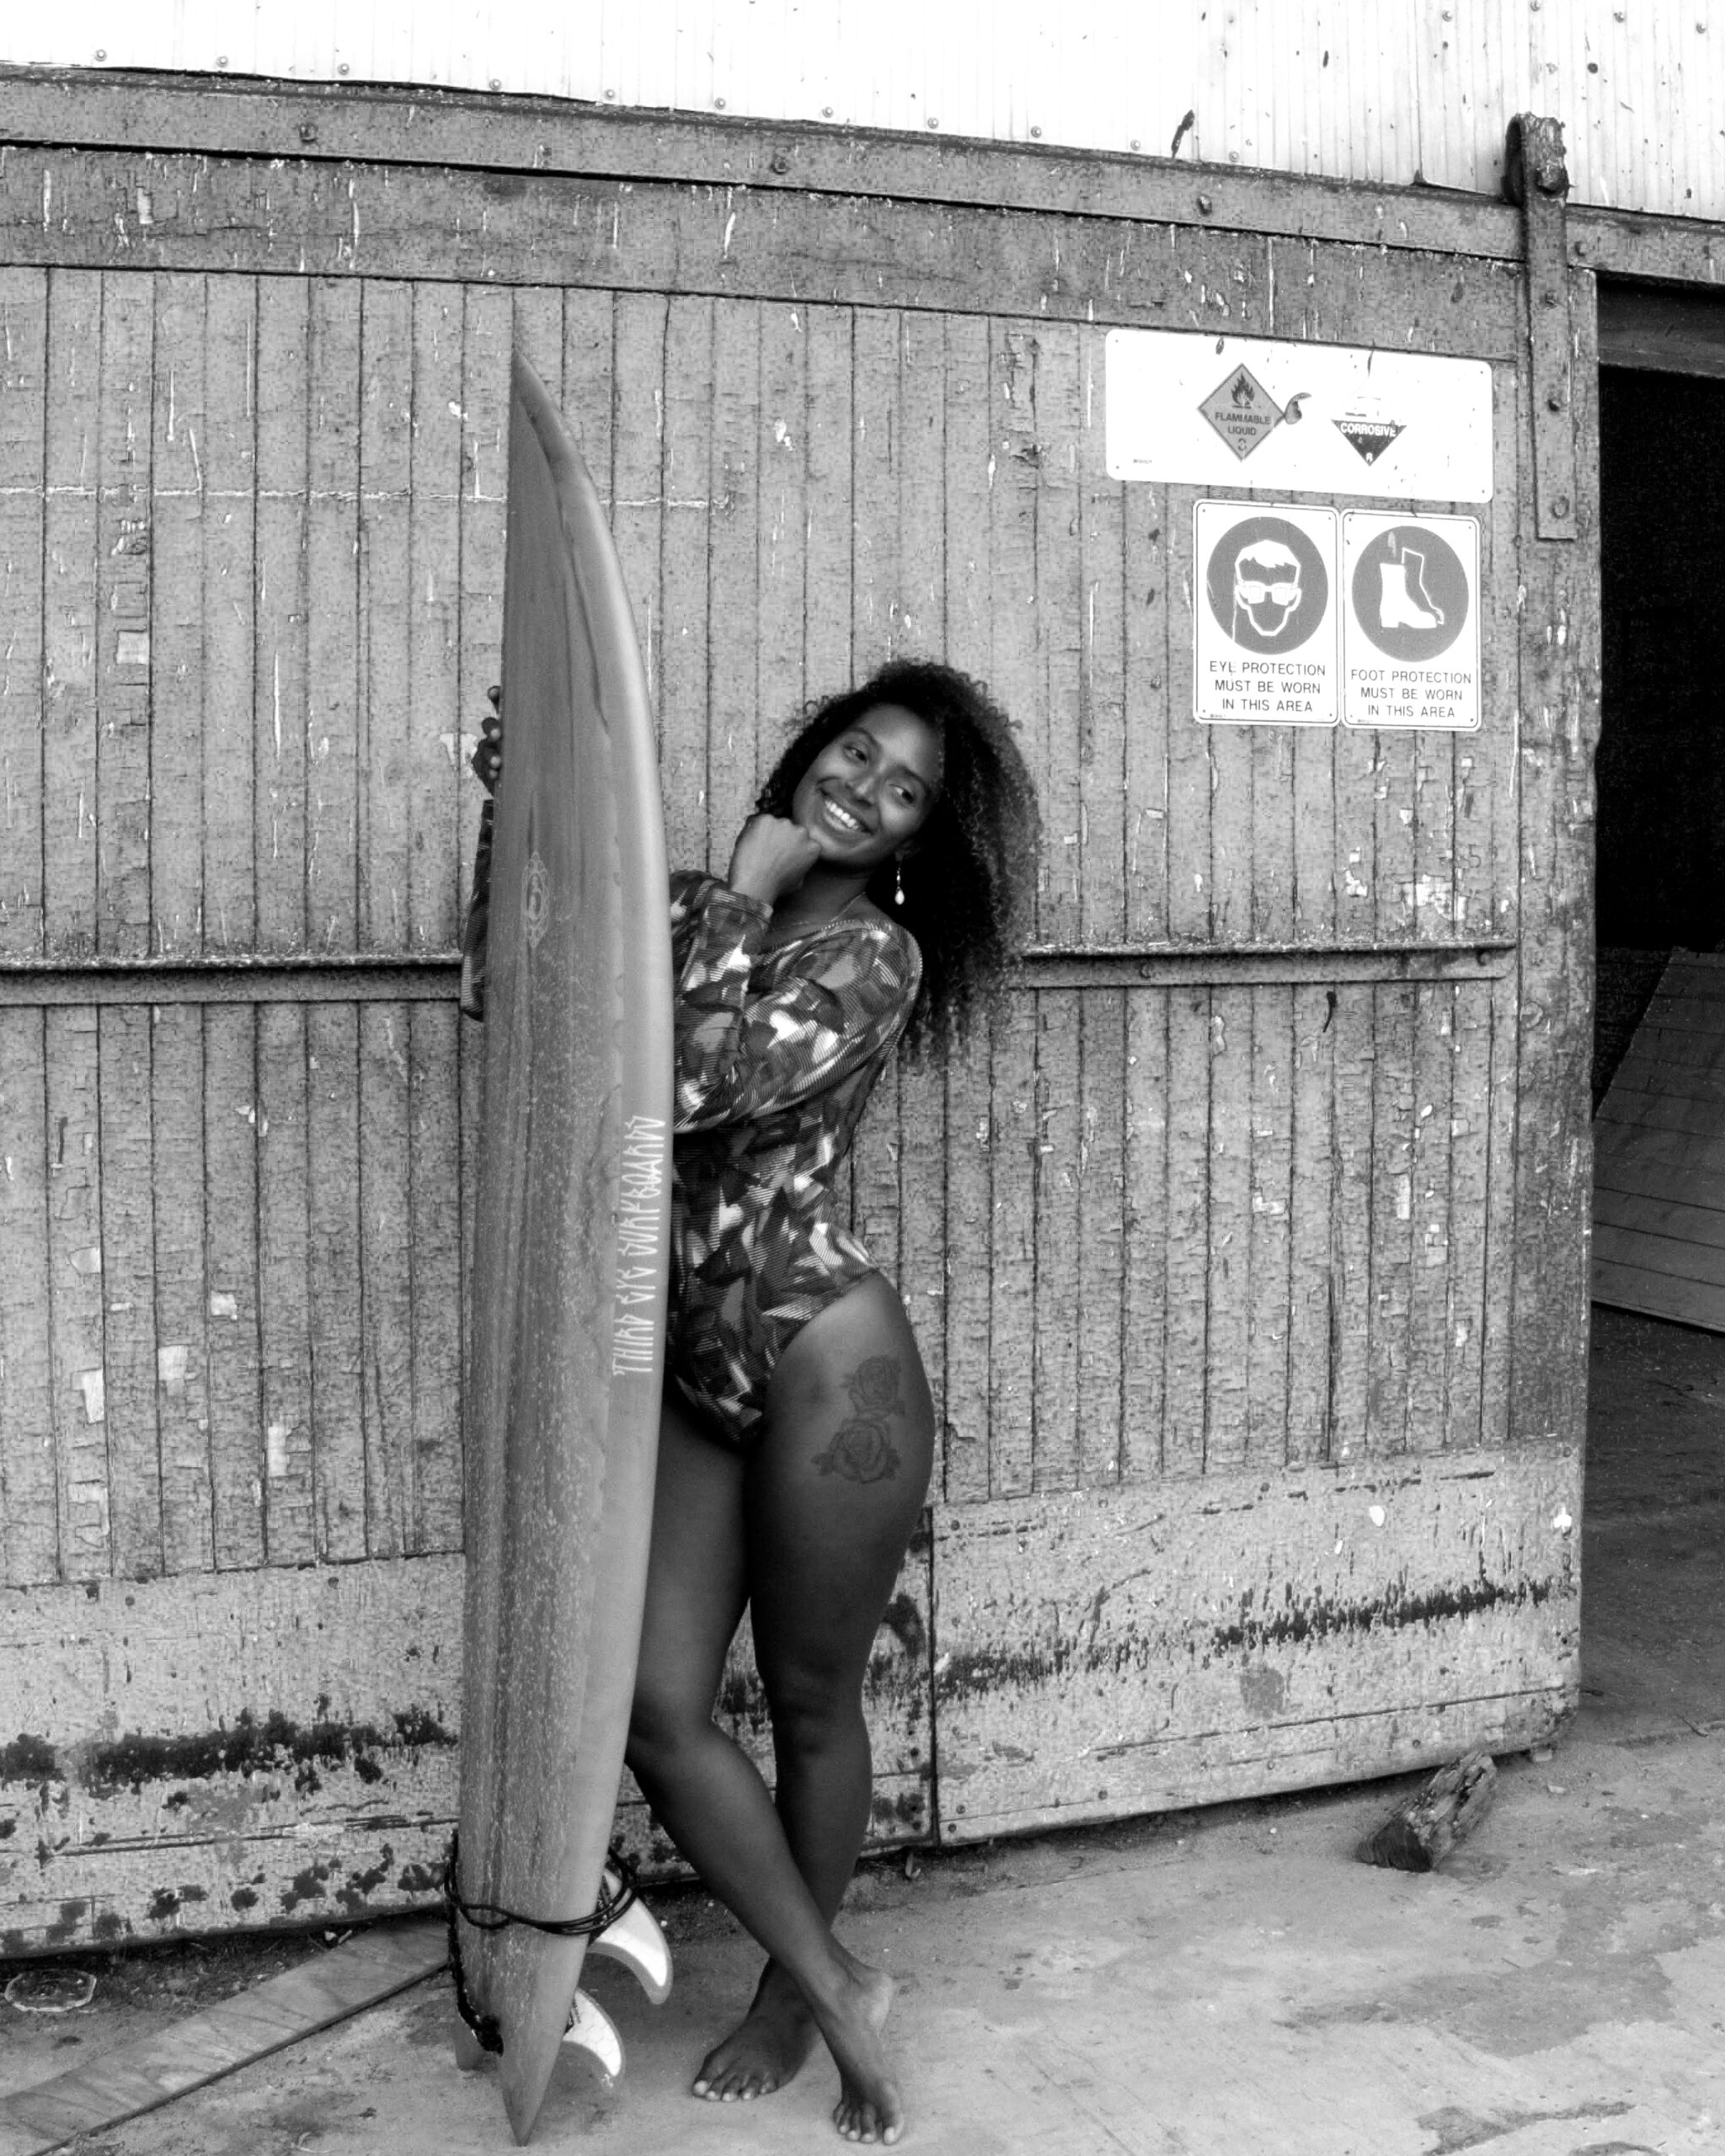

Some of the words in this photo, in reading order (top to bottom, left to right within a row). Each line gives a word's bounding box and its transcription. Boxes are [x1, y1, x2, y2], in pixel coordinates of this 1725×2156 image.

[1215, 412, 1272, 425] FLAMMABLE
[1227, 425, 1257, 436] LIQUID
[1340, 423, 1397, 437] CORROSIVE
[1237, 438, 1247, 451] 3
[1242, 662, 1326, 675] PROTECTION
[1351, 670, 1386, 681] FOOT
[1392, 670, 1472, 684] PROTECTION
[1215, 680, 1251, 691] MUST
[1258, 680, 1275, 693] BE
[1281, 681, 1321, 694] WORN
[1361, 687, 1395, 700] MUST
[1402, 688, 1418, 700] BE
[1424, 689, 1462, 701] WORN
[1222, 698, 1234, 710] IN
[1241, 699, 1269, 711] THIS
[1276, 700, 1313, 712] AREA
[1368, 705, 1380, 716] IN
[1386, 706, 1414, 717] THIS
[1421, 706, 1455, 718] AREA
[617, 1115, 665, 1257] SURFBOARDS
[616, 1266, 657, 1305] EYE
[612, 1313, 655, 1376] THIRD
